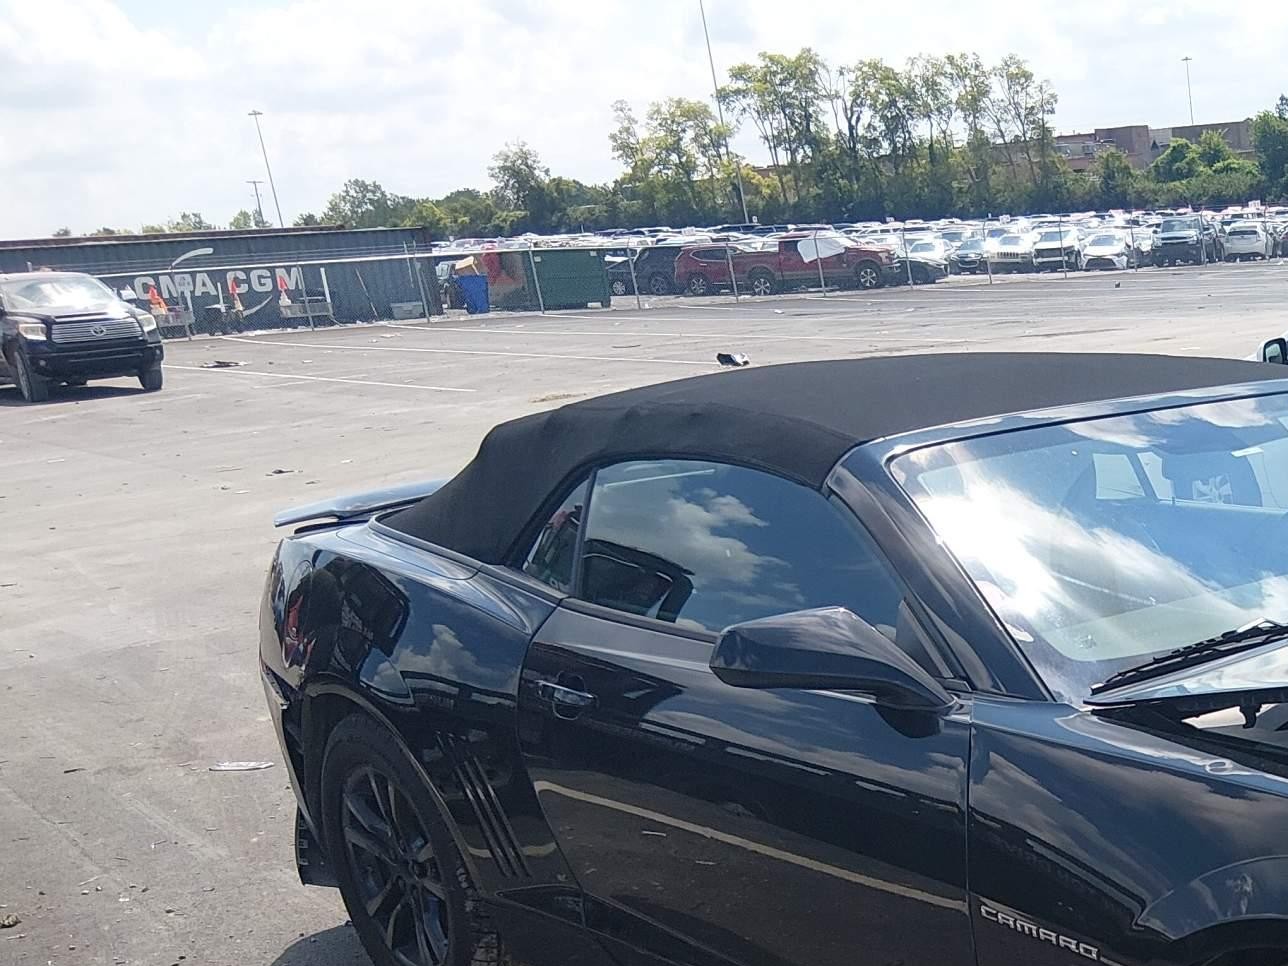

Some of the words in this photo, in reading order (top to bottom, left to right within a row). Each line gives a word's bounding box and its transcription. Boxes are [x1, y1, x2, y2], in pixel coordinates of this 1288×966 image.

[133, 272, 218, 301] CMA
[226, 266, 303, 295] CGM
[980, 904, 1099, 961] CAMARO
